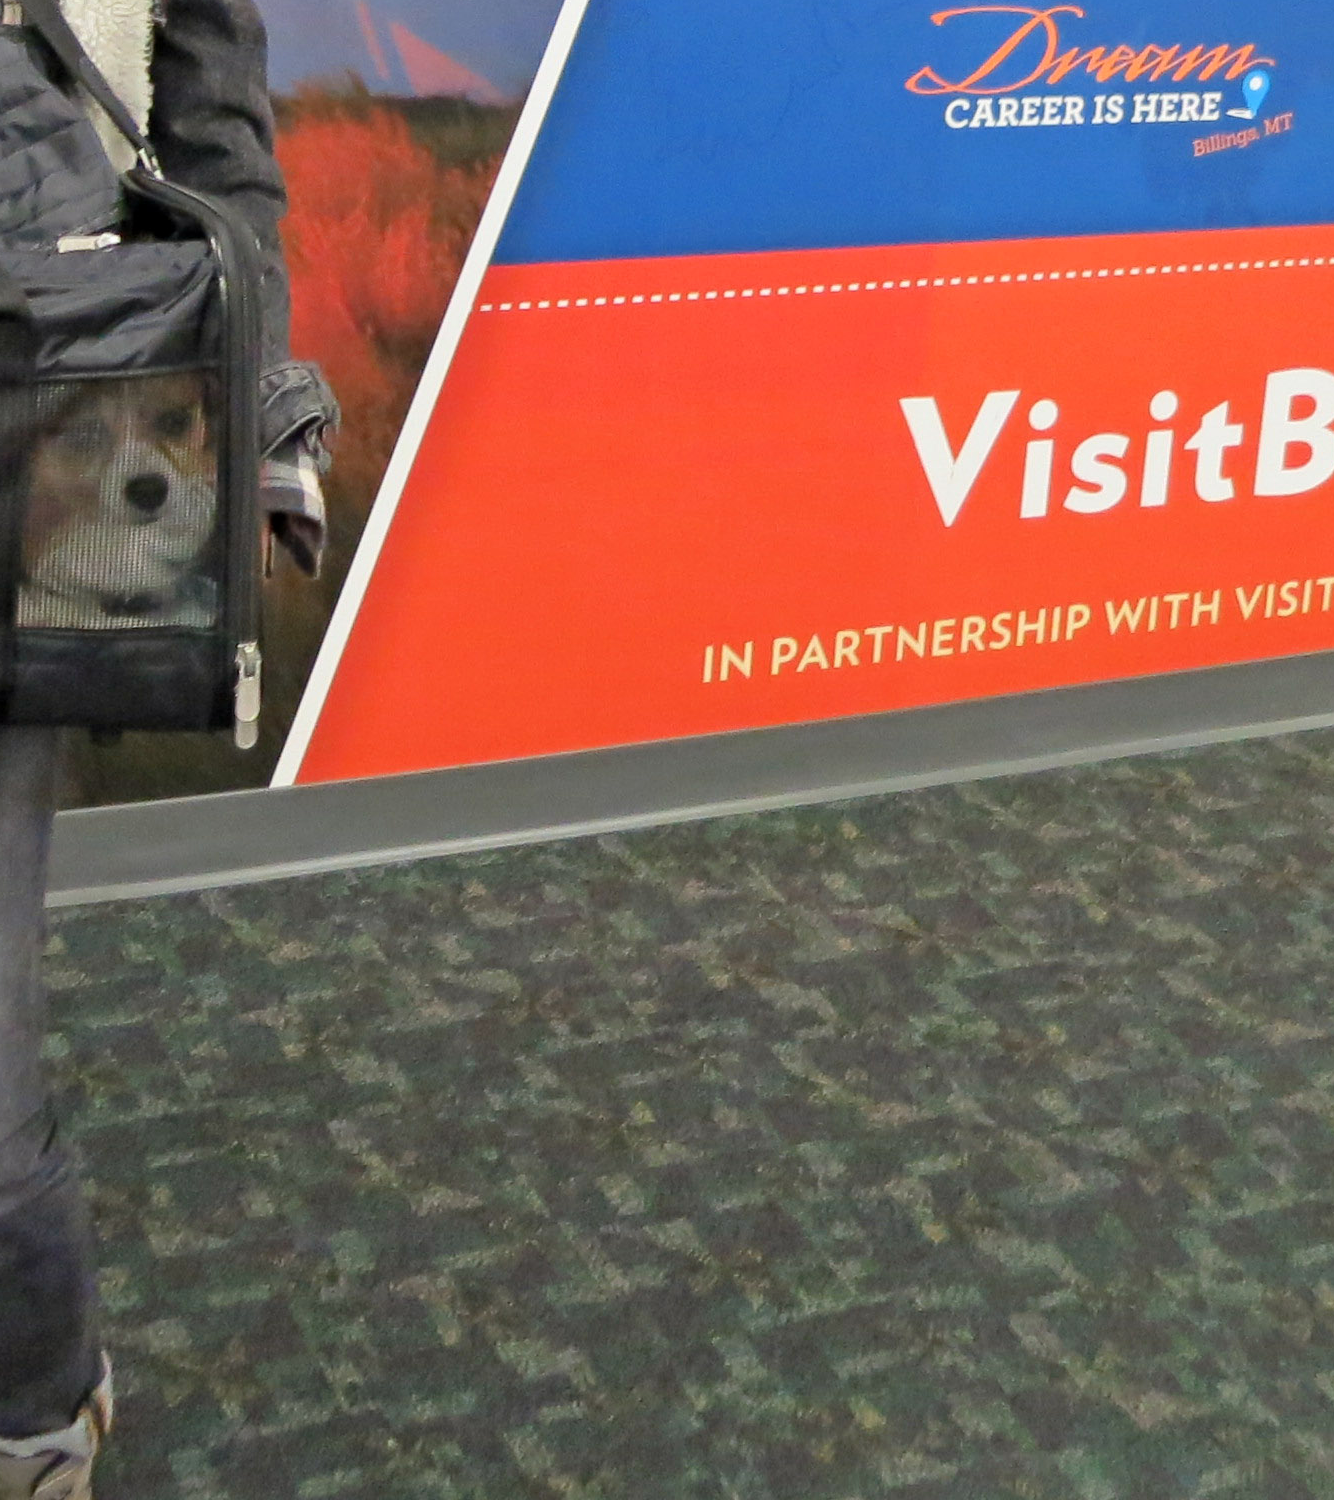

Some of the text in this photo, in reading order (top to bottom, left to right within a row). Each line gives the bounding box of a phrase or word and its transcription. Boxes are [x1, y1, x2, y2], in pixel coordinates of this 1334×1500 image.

[905, 5, 1276, 94] Dream
[945, 92, 1222, 129] CAREER IS HERE
[1264, 112, 1293, 135] MT
[701, 640, 755, 684] IN
[770, 603, 1092, 676] PARTNERSHIP
[1104, 590, 1222, 636] WITH
